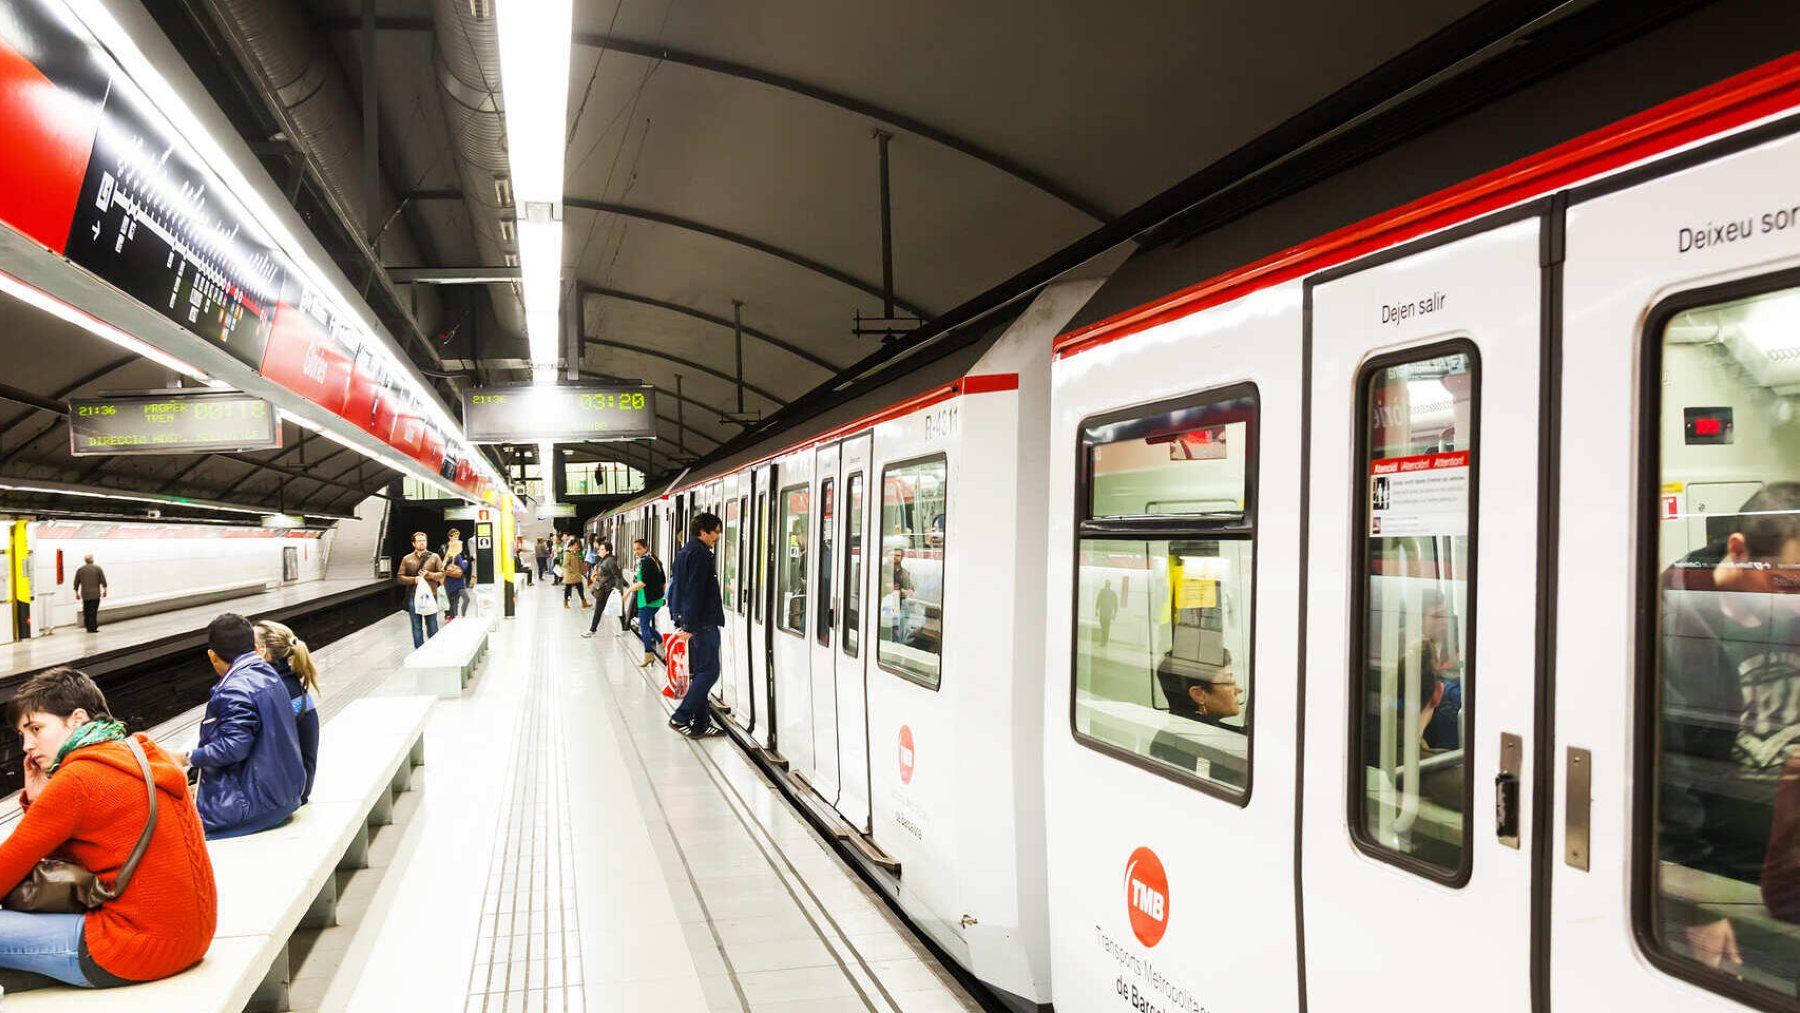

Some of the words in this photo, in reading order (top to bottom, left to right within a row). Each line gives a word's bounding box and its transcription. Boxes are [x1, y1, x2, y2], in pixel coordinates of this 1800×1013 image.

[1679, 221, 1753, 252] Deixeu
[1382, 302, 1415, 325] Dejen
[1419, 291, 1446, 315] salir
[78, 405, 117, 417] 21:36
[580, 393, 646, 410] 03:20
[1132, 878, 1165, 922] TMB
[1096, 925, 1142, 976] Transports
[1117, 975, 1128, 1000] de
[1132, 983, 1166, 1013] Bar
